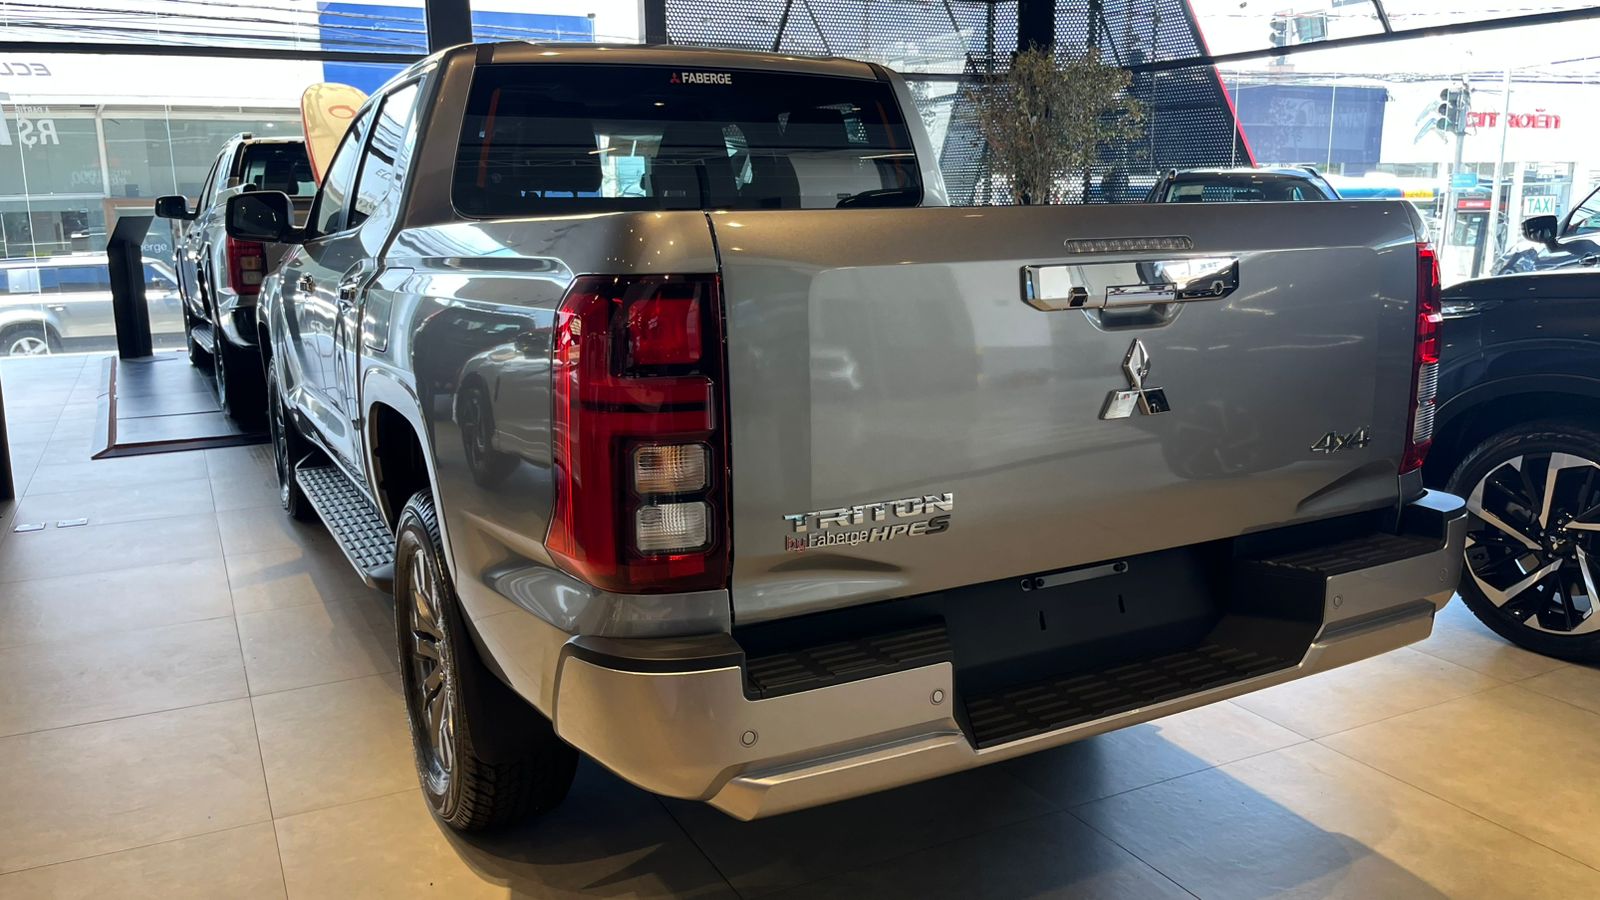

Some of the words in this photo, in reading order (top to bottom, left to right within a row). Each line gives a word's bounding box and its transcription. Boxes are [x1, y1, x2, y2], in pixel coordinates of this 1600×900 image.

[681, 72, 732, 84] FABERGE
[1527, 198, 1554, 214] TAXI
[142, 242, 168, 254] erge
[783, 492, 953, 533] TRITON
[808, 530, 868, 549] Faberge
